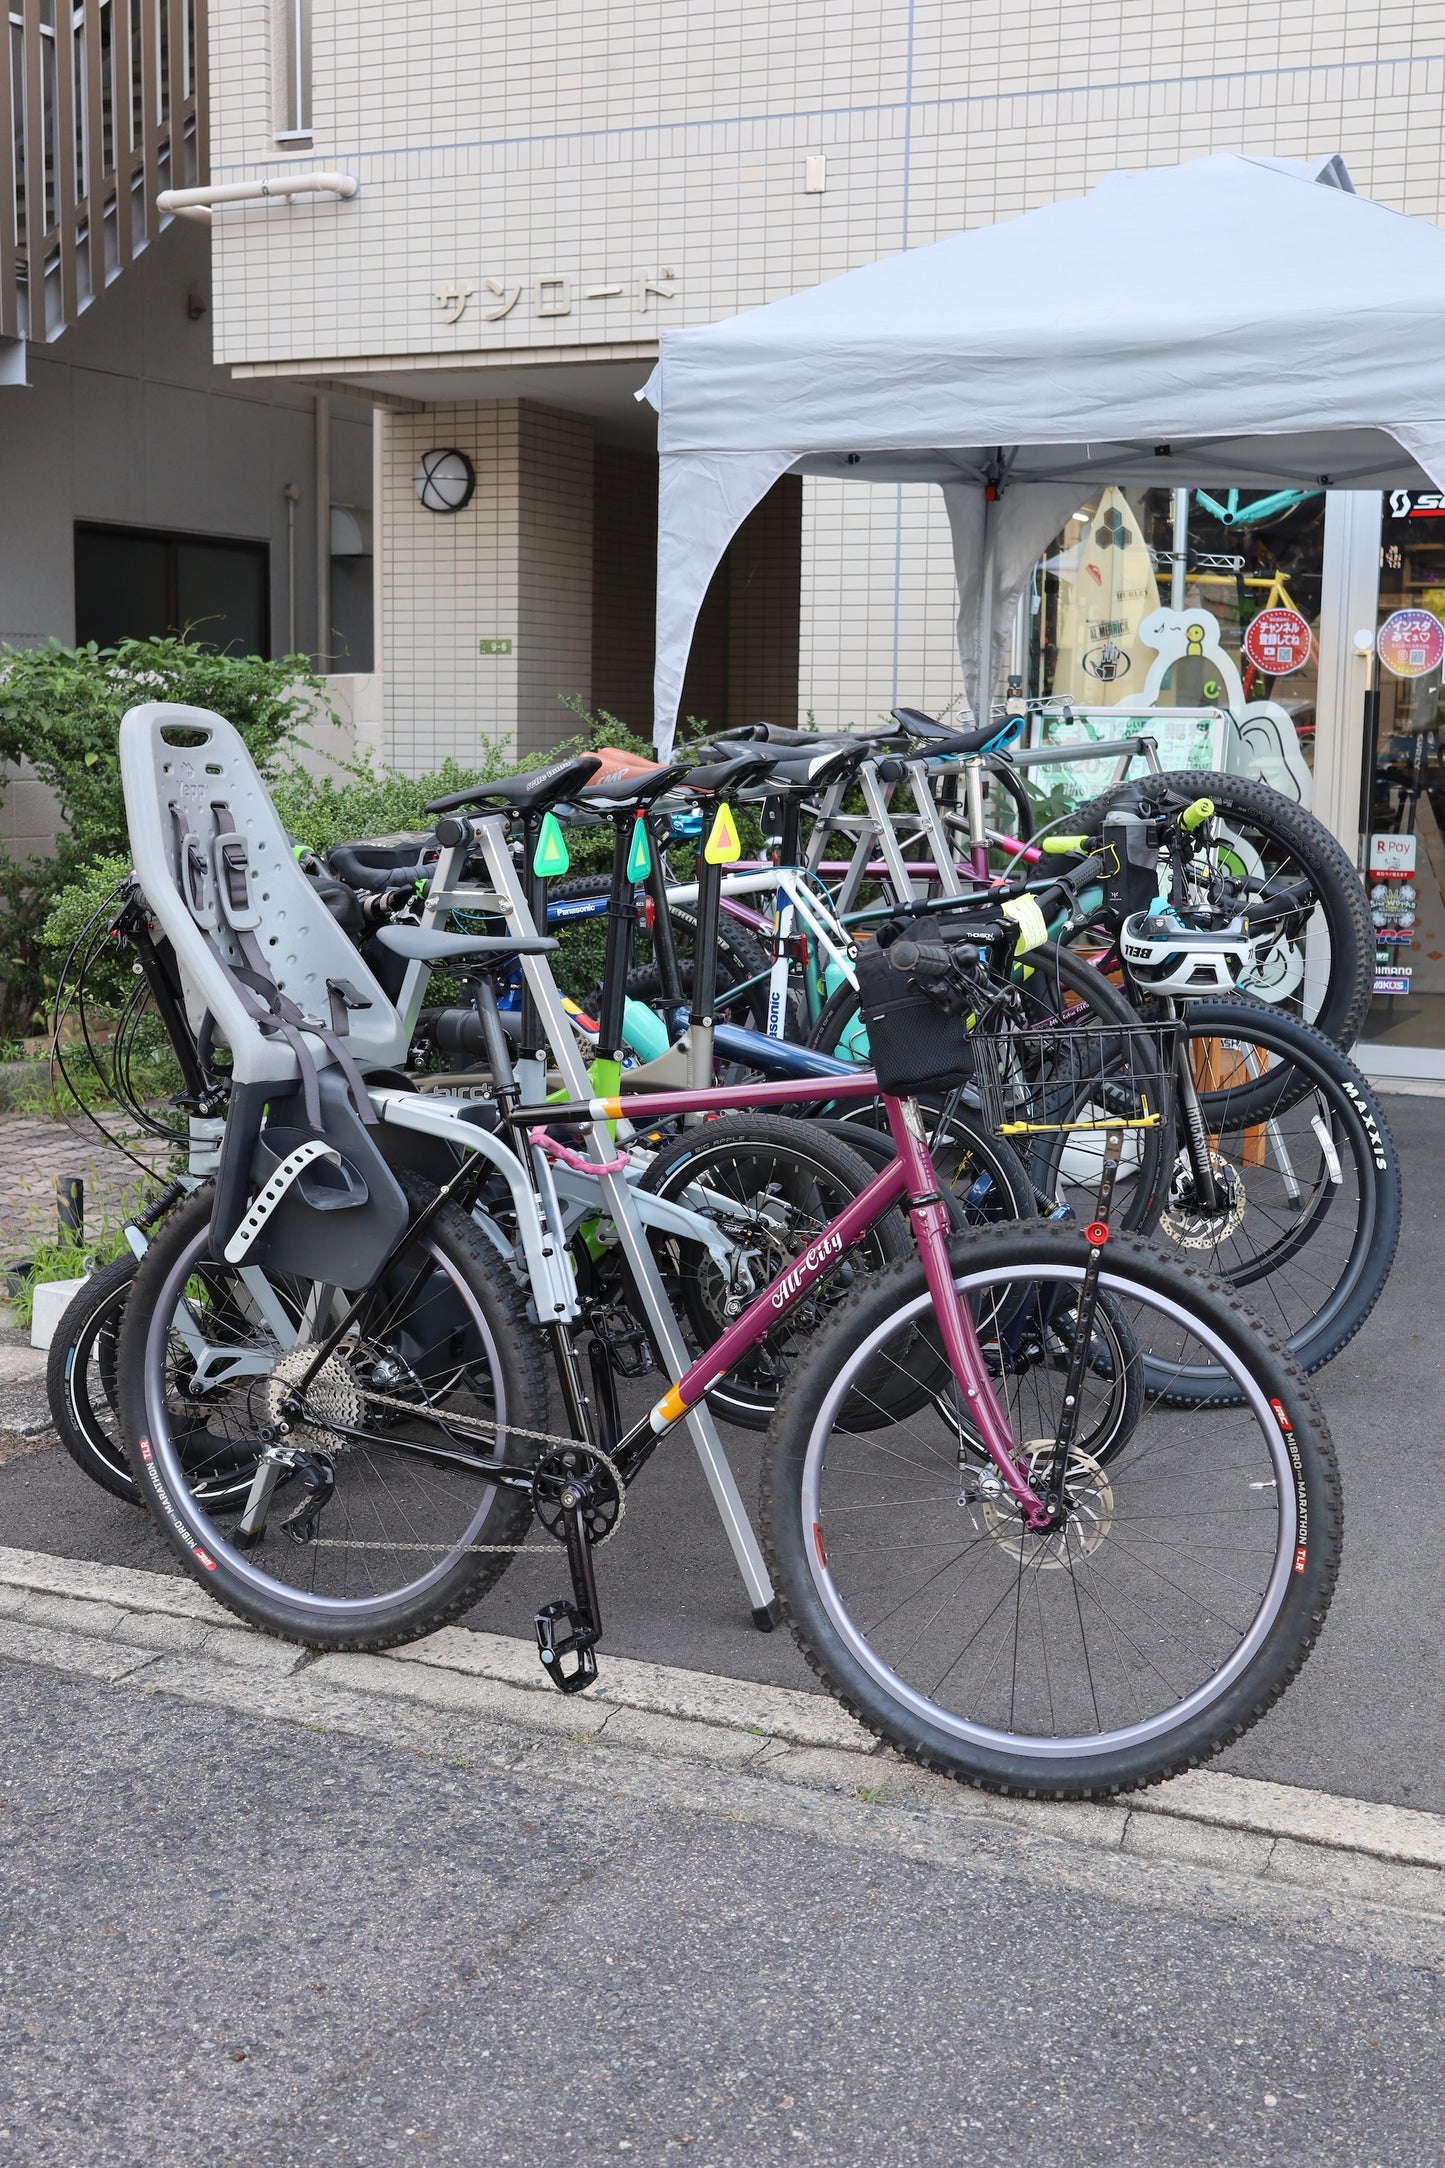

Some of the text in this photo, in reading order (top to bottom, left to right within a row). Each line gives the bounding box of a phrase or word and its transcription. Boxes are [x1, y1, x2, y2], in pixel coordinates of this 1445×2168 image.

[435, 266, 675, 324] サンロード
[1260, 622, 1300, 634] チャンネル
[1392, 620, 1432, 632] インスタ
[1388, 841, 1411, 855] Pay
[556, 904, 596, 917] Panasonic
[1125, 944, 1154, 960] BELL
[1341, 1081, 1387, 1171] MAXXIS
[694, 1142, 710, 1154] BIG
[713, 1135, 745, 1146] APPLE
[771, 1232, 843, 1309] All-City
[63, 1382, 80, 1432] SCHWALBE
[81, 1298, 102, 1330] APPLE
[139, 1440, 152, 1461] TLR
[1285, 1432, 1303, 1470] MIBRO
[146, 1462, 175, 1515] MARATHON
[1297, 1481, 1308, 1545] MARATHON
[173, 1520, 198, 1549] MIBRO
[1295, 1549, 1307, 1572] TLR
